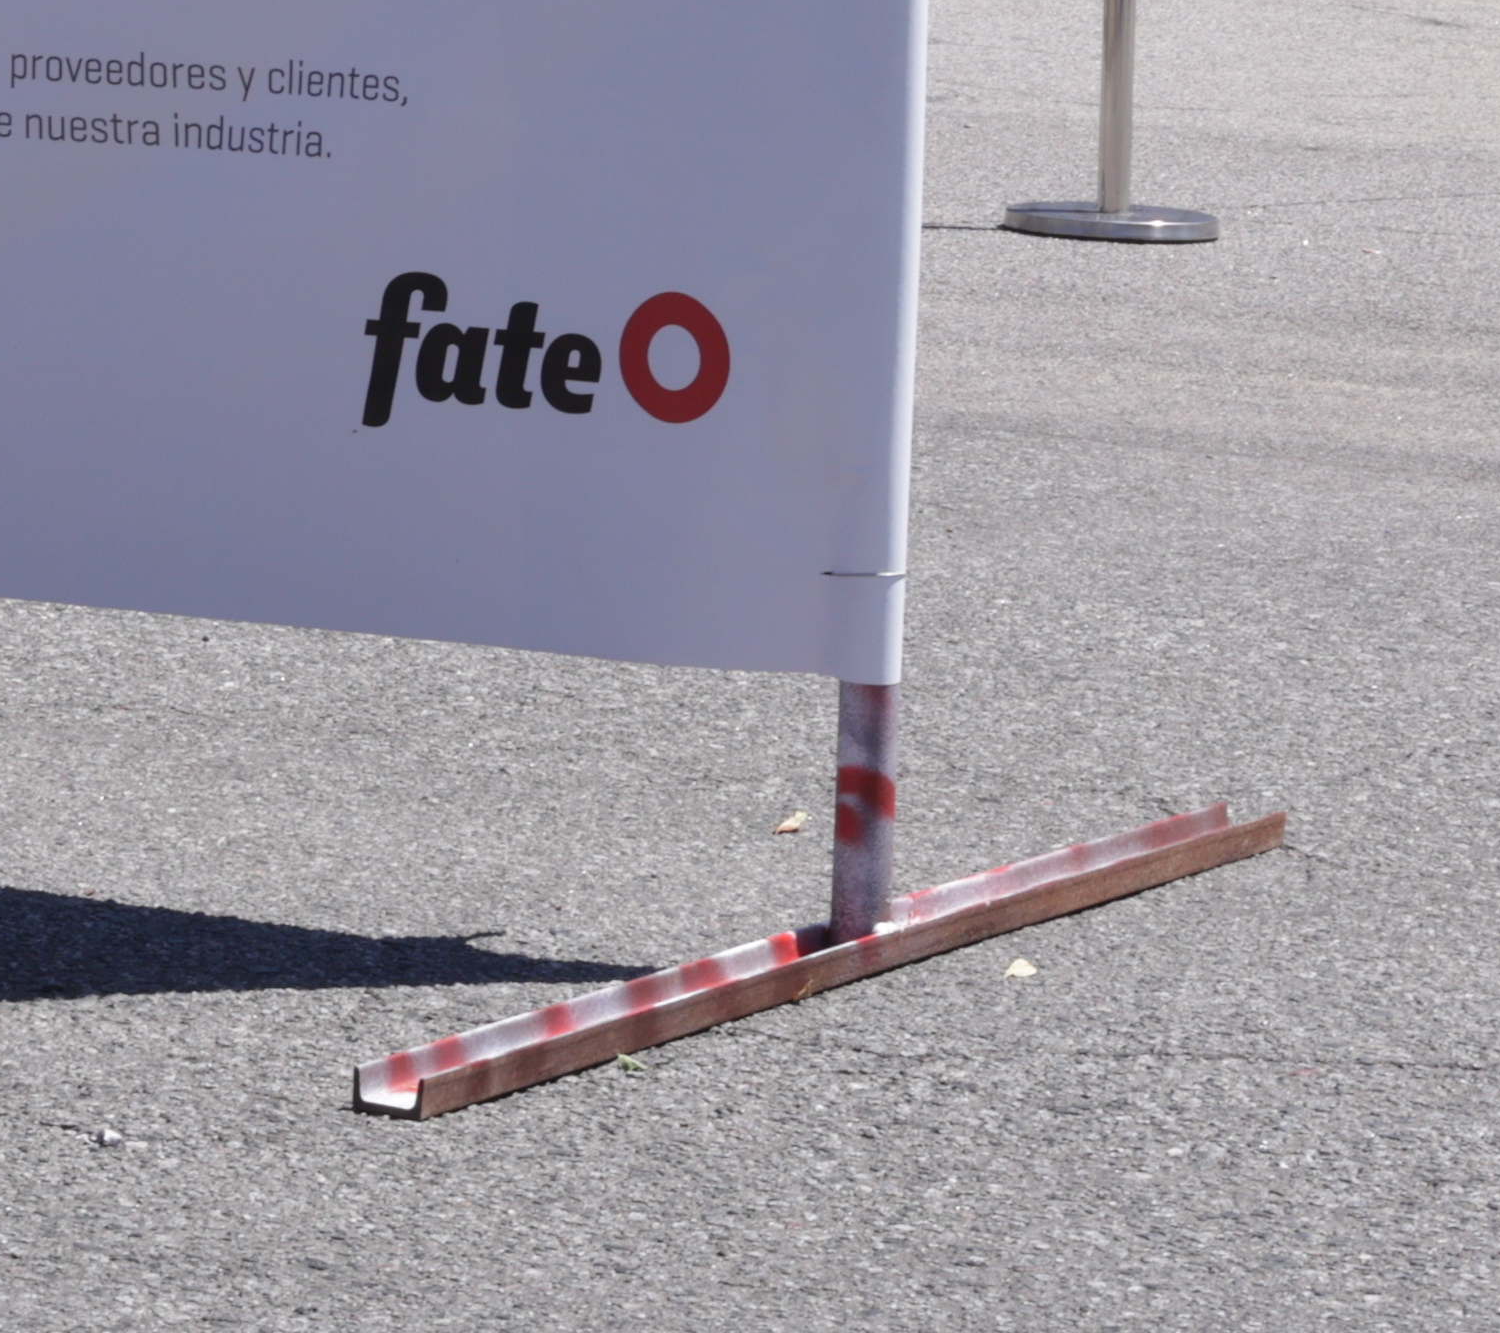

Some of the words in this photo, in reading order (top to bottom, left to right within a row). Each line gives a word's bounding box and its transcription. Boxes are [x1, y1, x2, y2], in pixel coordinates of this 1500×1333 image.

[10, 51, 227, 91] proveedores
[237, 66, 256, 102] y
[267, 59, 408, 107] clientes,
[25, 113, 161, 147] nuestra
[173, 112, 332, 159] industria.
[362, 271, 604, 429] fate
